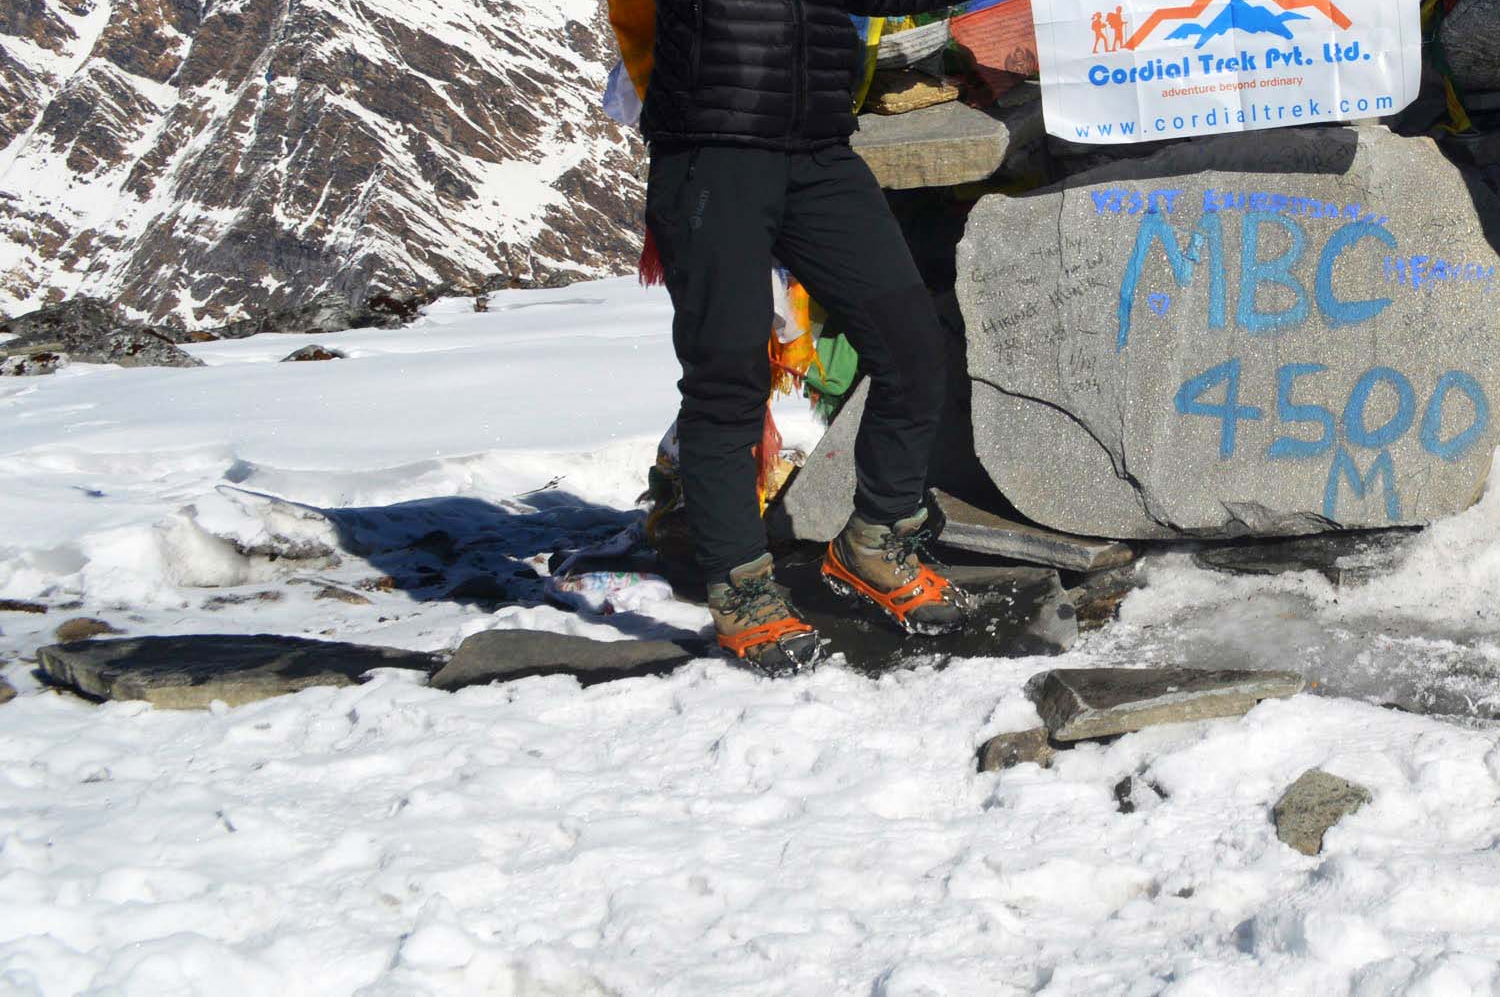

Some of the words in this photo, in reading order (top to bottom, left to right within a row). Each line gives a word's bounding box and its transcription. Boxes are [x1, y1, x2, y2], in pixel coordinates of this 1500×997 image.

[1088, 56, 1190, 86] Cordial
[1198, 51, 1257, 75] Trek
[1265, 46, 1314, 69] Pvt.
[1323, 41, 1372, 64] Ltd.
[1161, 83, 1216, 98] adventure
[1219, 78, 1257, 94] beyond
[1259, 75, 1304, 89] ordinary
[1116, 210, 1398, 353] MBC
[1173, 357, 1490, 460] 4500
[1321, 448, 1400, 522] M
